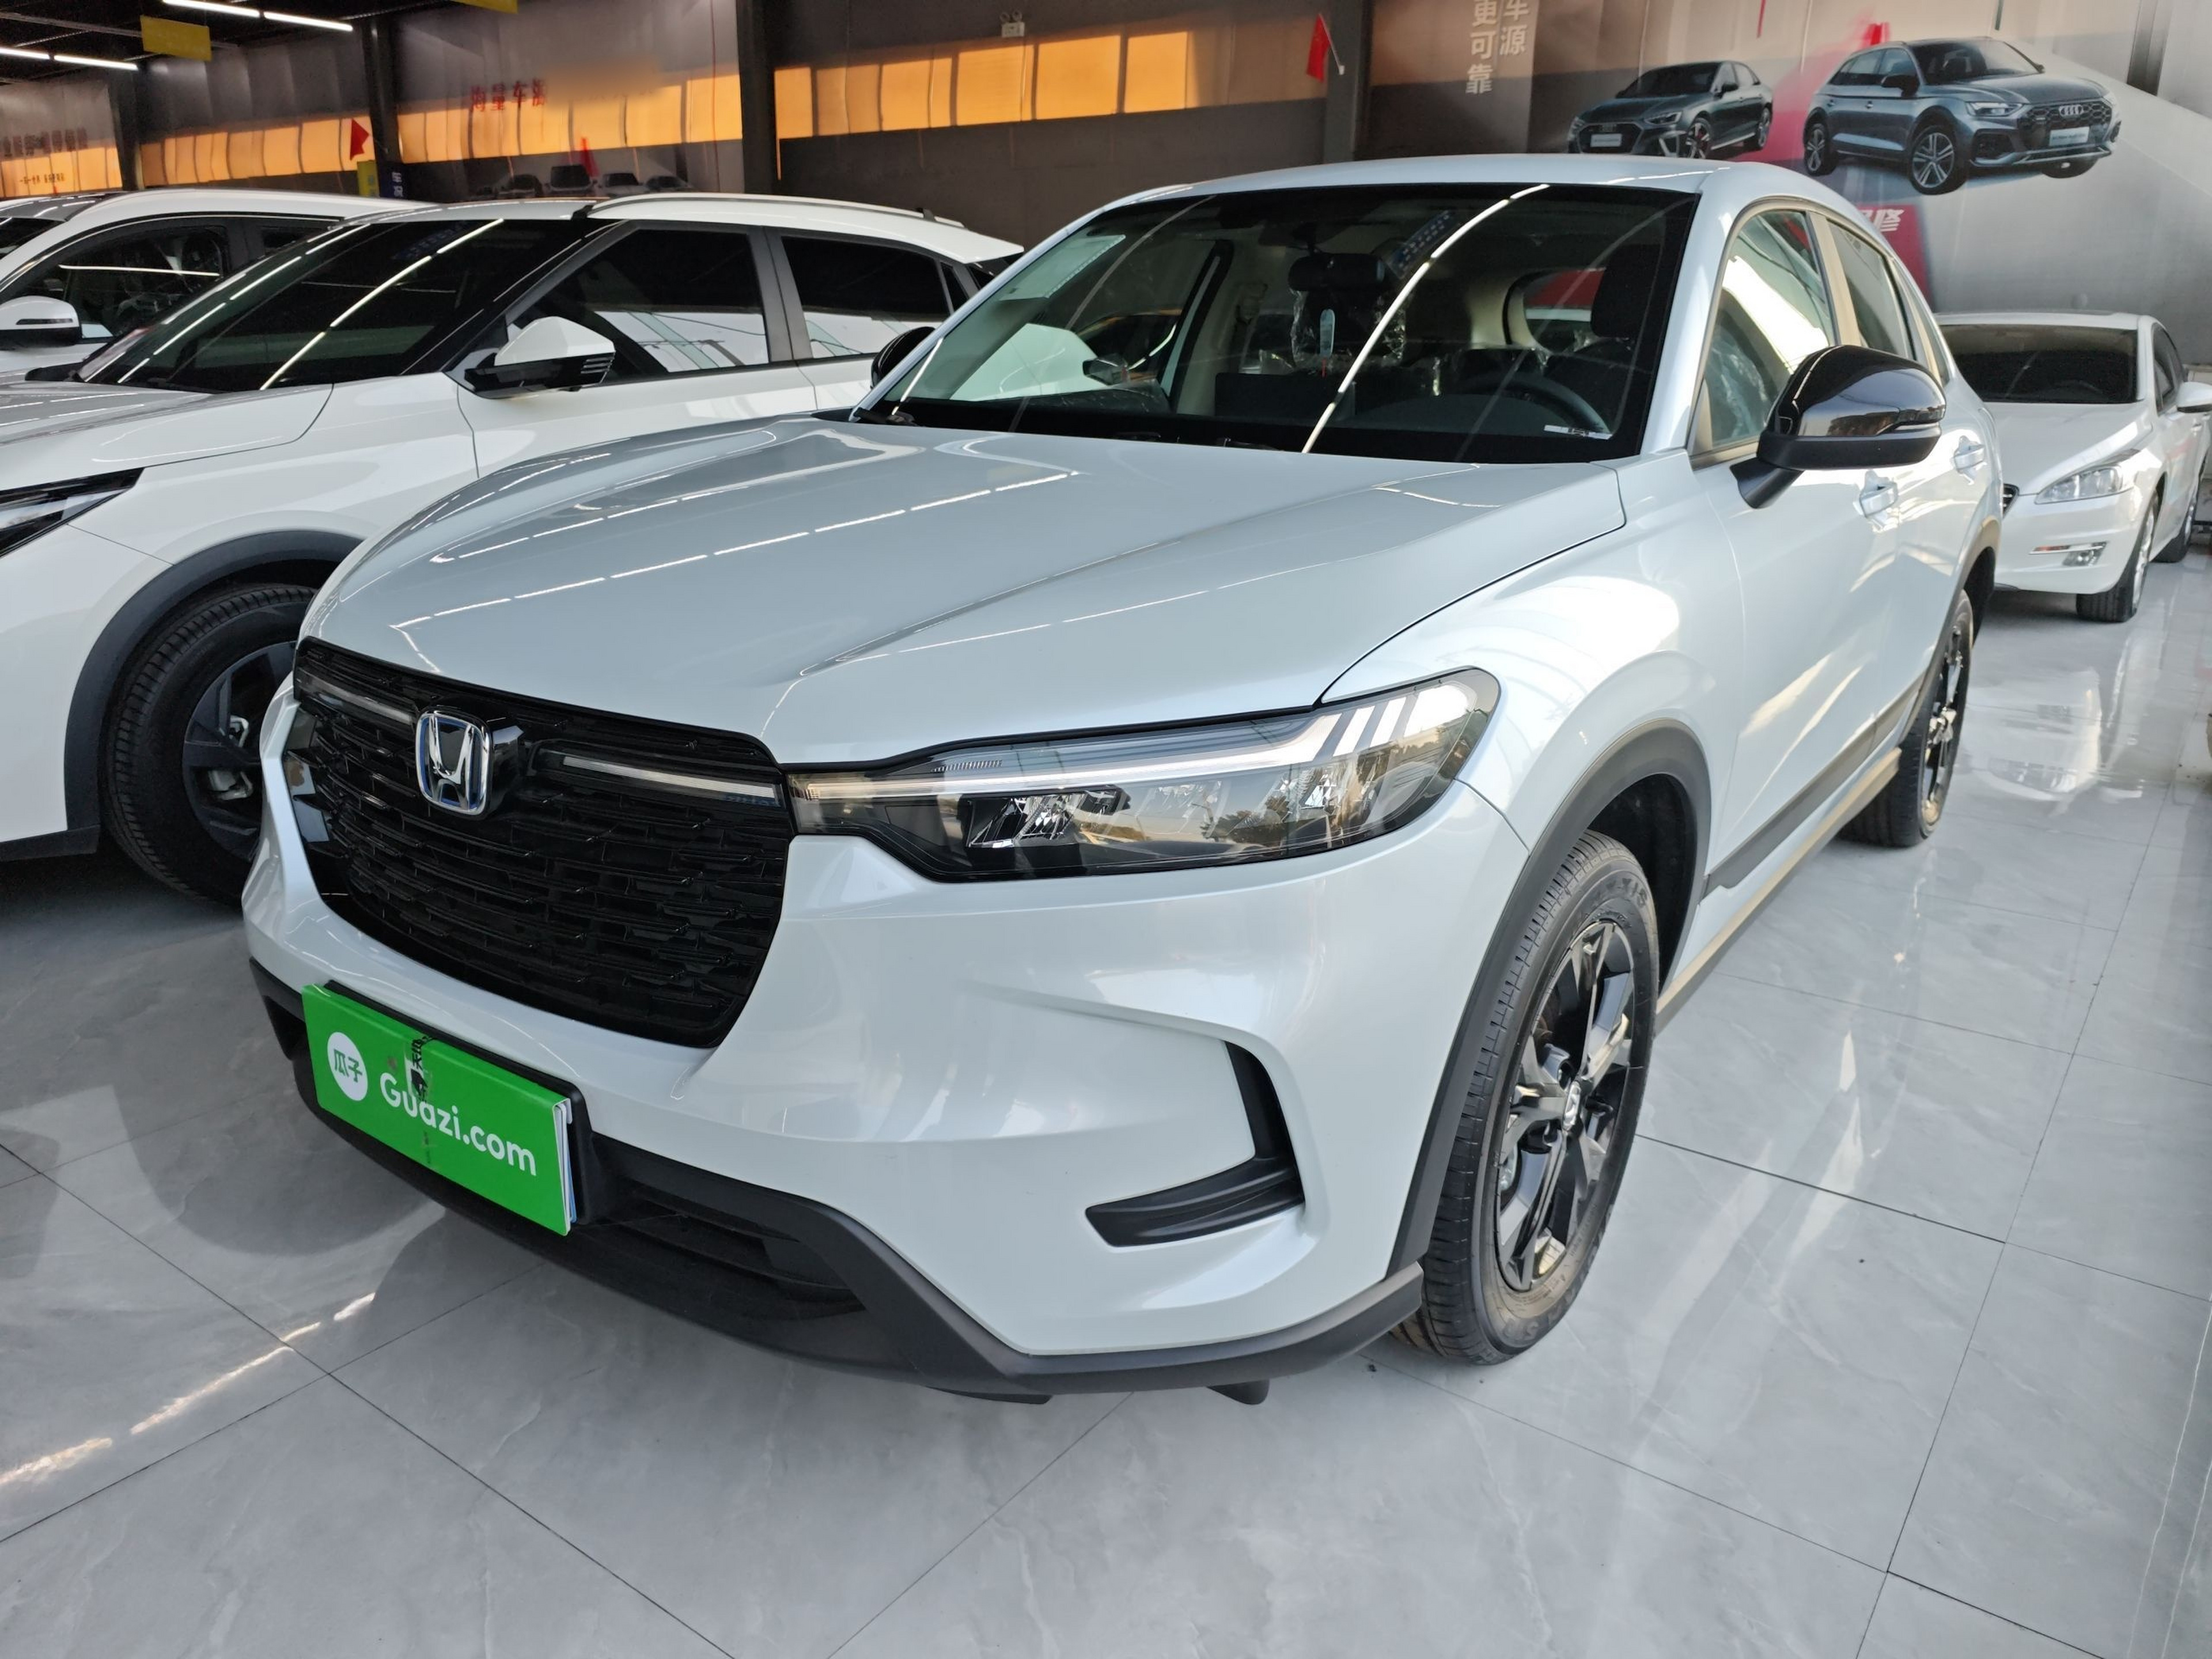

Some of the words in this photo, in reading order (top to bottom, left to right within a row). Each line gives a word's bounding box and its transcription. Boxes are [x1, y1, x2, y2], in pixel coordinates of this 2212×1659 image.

[1465, 0, 1497, 94] 更可靠
[1499, 0, 1529, 56] 车源
[334, 1048, 363, 1083] 瓜子
[380, 1072, 537, 1176] Guazi.com
